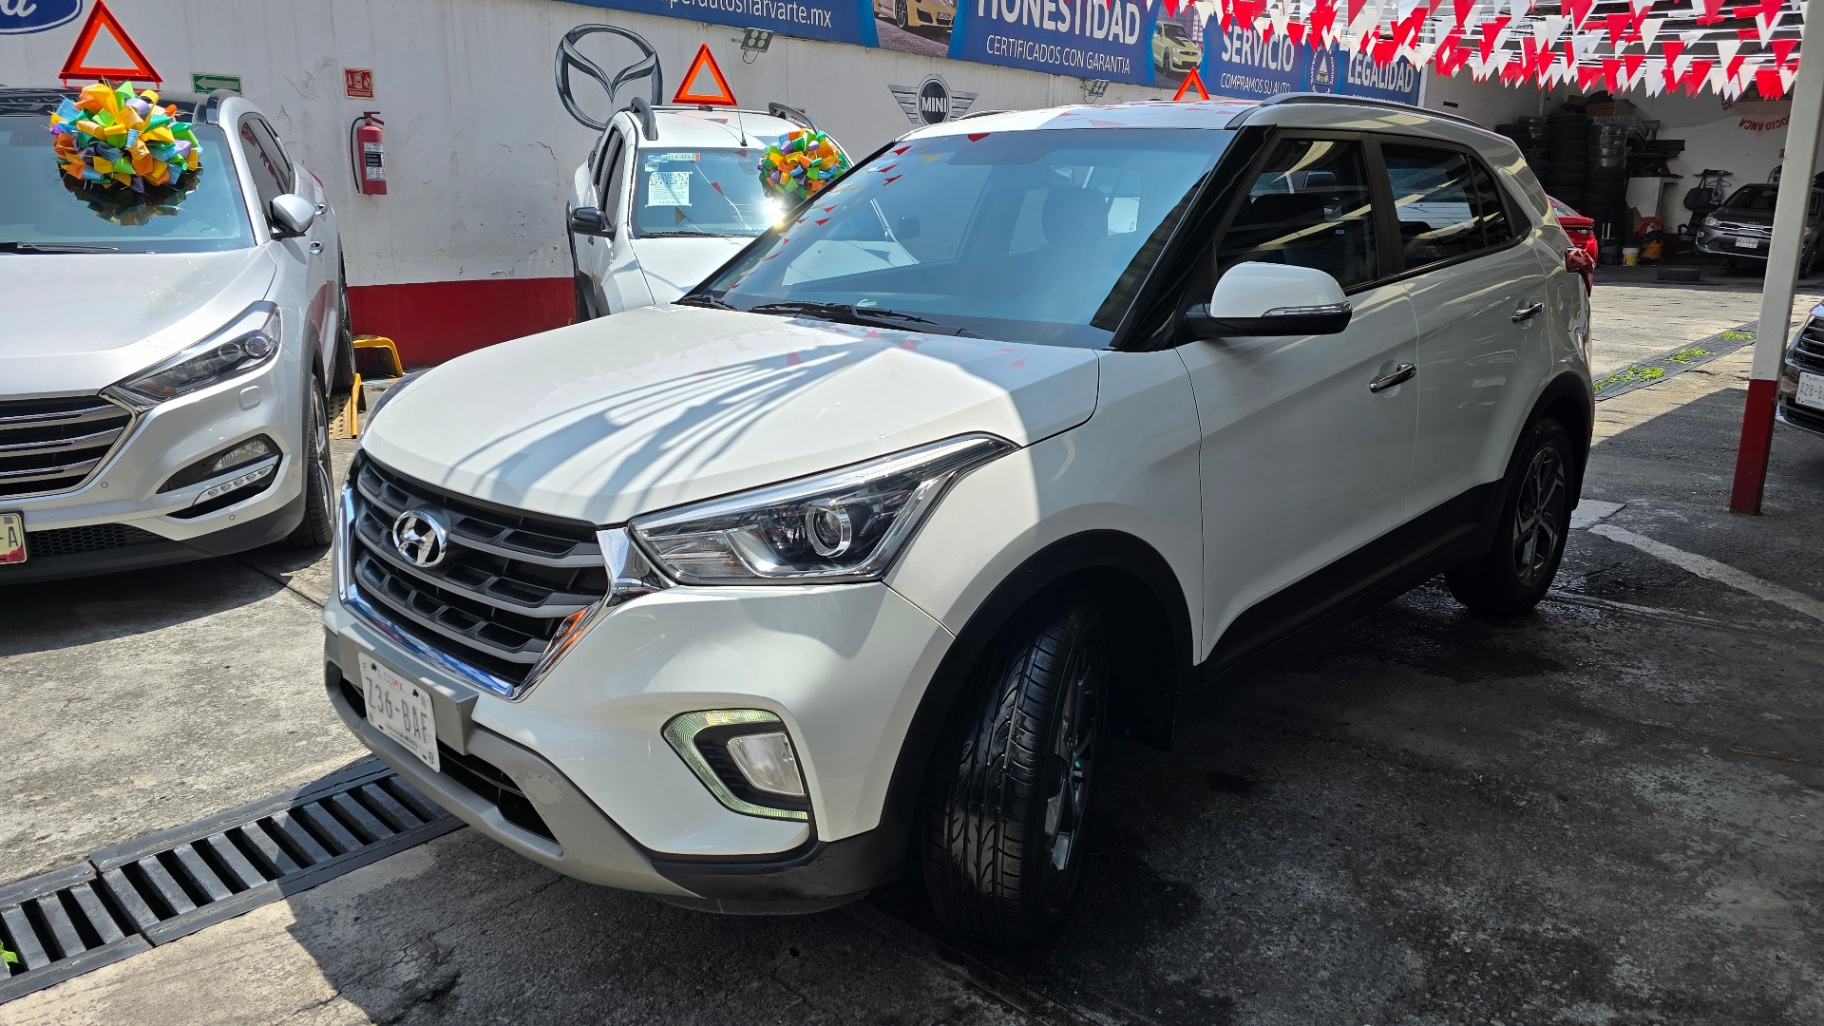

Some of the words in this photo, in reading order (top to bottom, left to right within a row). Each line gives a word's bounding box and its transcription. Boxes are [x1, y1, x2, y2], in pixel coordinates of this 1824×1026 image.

[986, 34, 1061, 65] CERTIFICADOS
[1063, 48, 1084, 68] CON
[1221, 25, 1295, 72] SERVICIO
[1220, 72, 1262, 93] COMPRAMOS
[1263, 79, 1273, 95] SU
[1273, 81, 1291, 95] AUTO
[1347, 52, 1415, 93] LEGALIDAD
[921, 96, 947, 112] MINI
[366, 676, 427, 744] Z36-BAF
